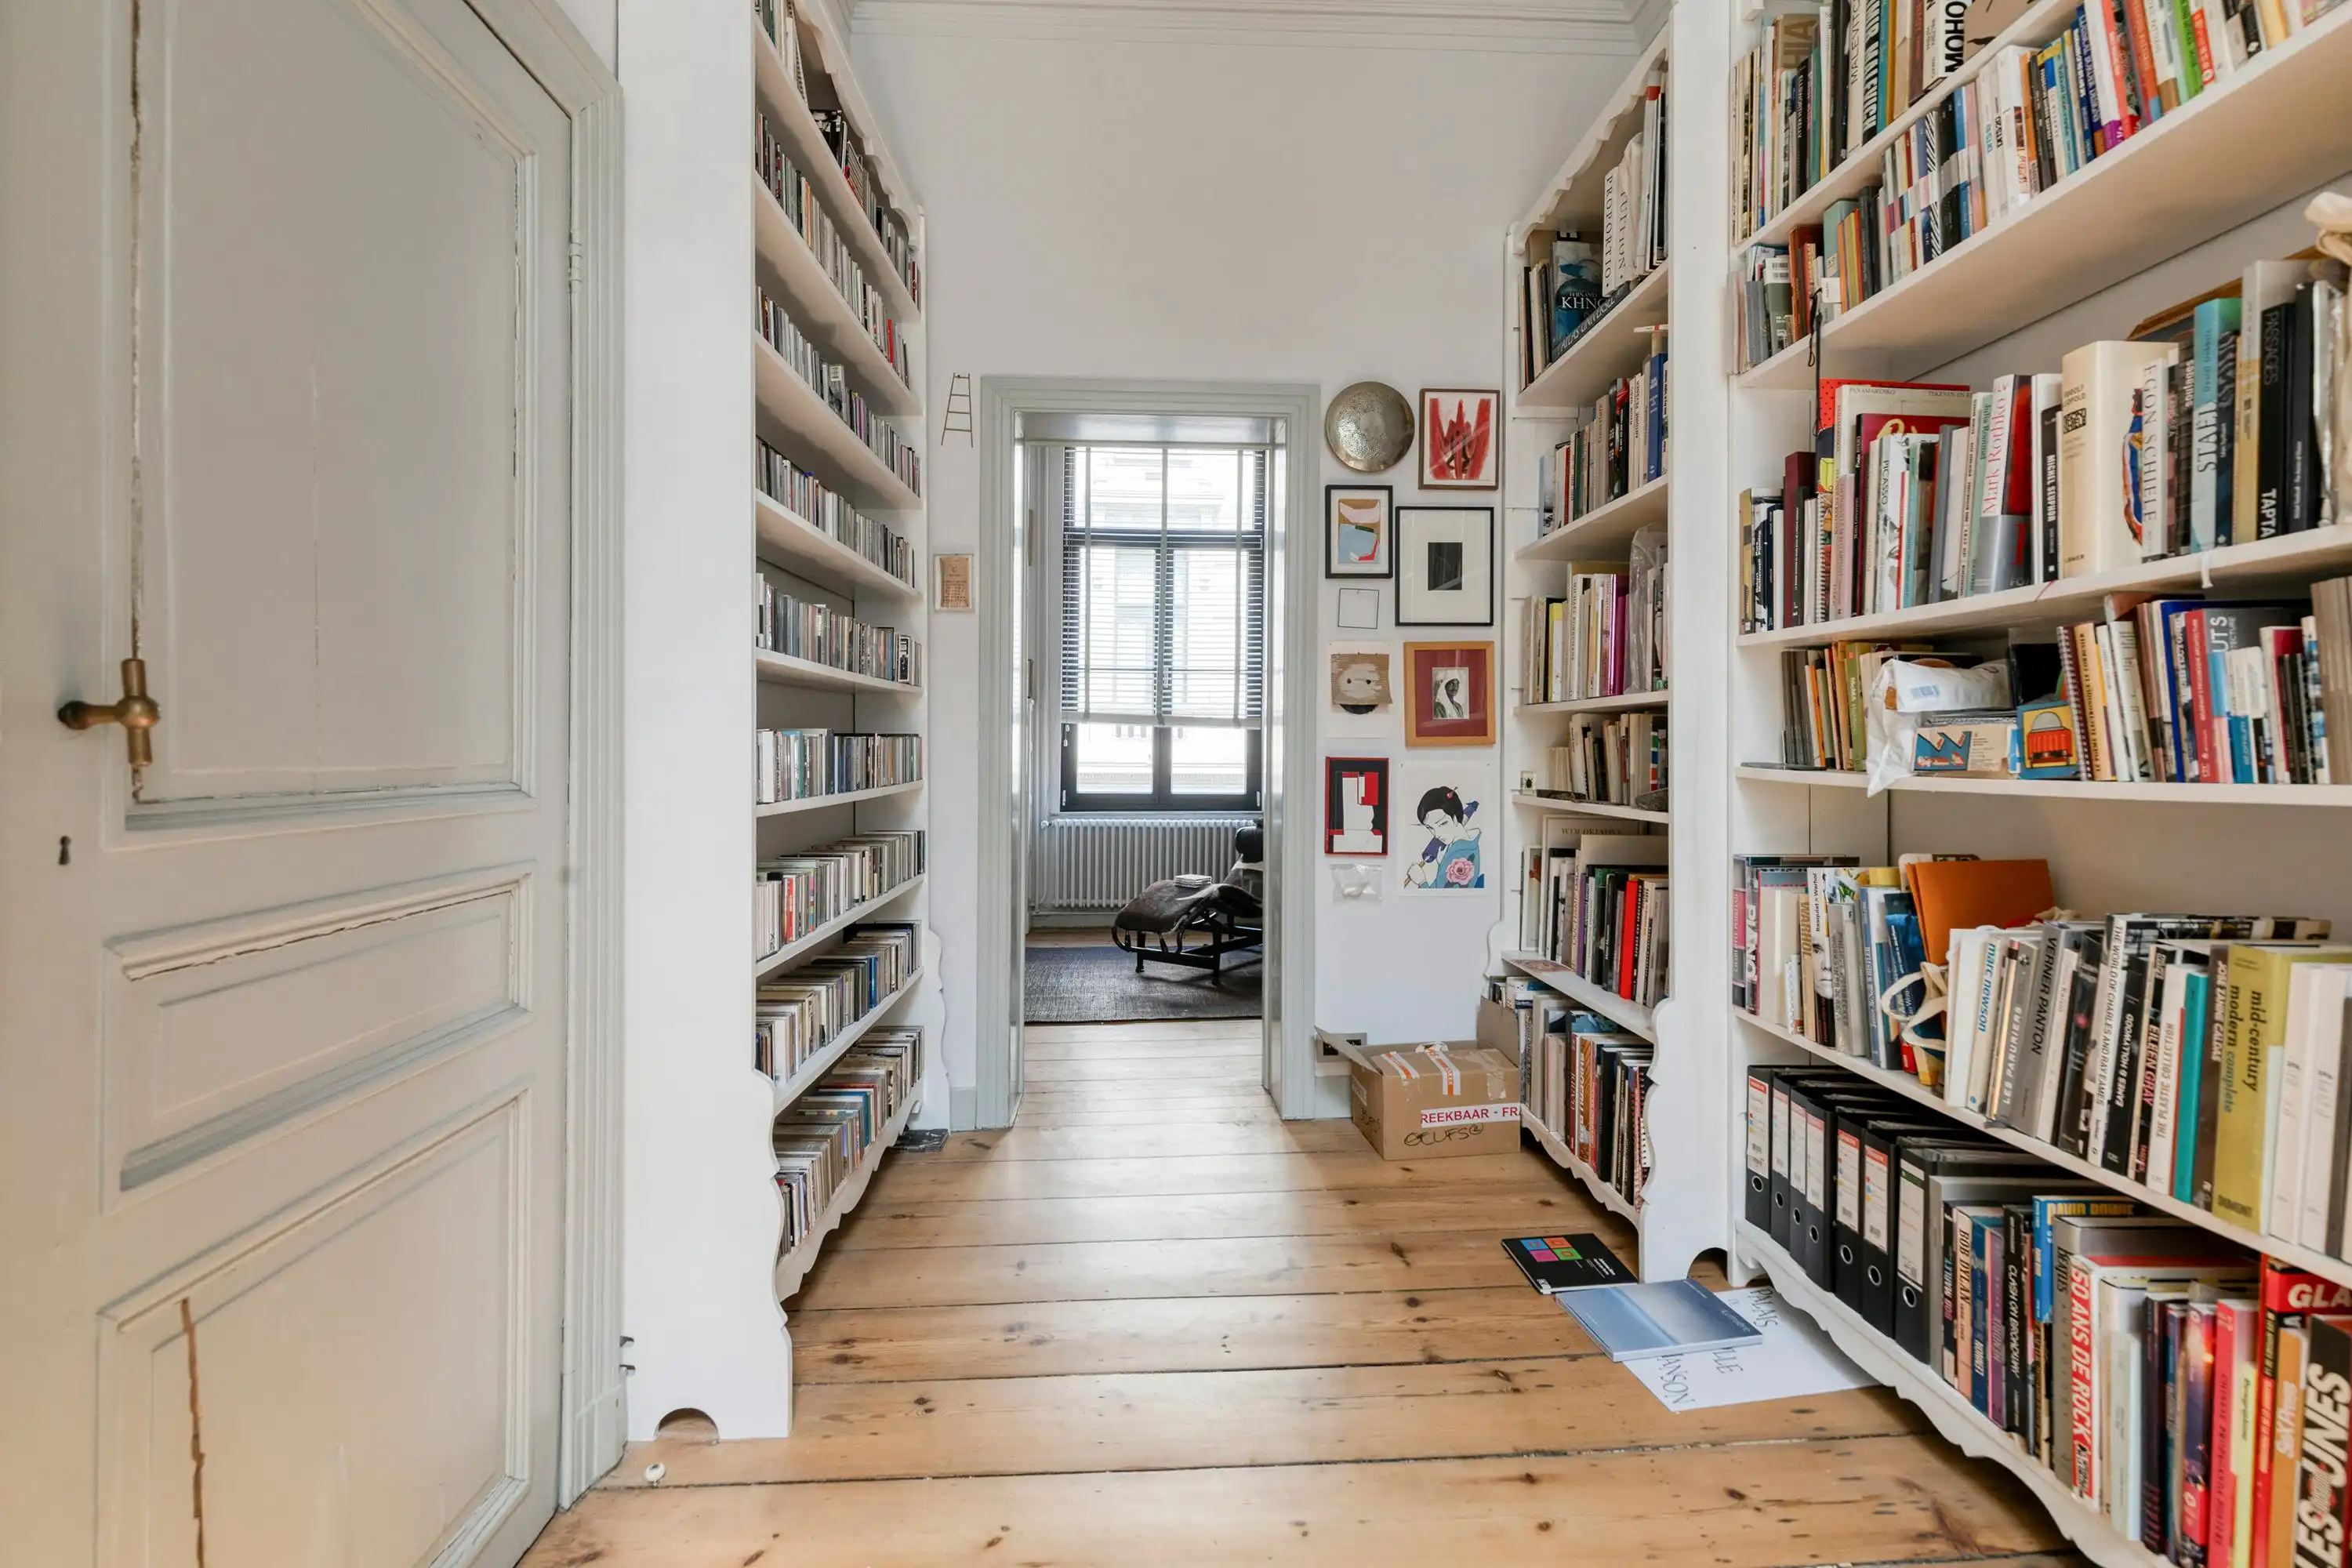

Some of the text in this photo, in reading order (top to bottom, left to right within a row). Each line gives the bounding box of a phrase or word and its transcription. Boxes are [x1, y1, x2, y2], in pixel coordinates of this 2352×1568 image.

[1605, 175, 1613, 278] PROPORTIO
[1982, 397, 2007, 514] Mark Rothko
[2143, 364, 2158, 523] EGON SCHIELE
[2196, 408, 2216, 473] STAEL
[1881, 459, 1889, 506] PICASSO
[2046, 454, 2056, 485] MICHEL
[2260, 488, 2277, 538] TAPTA
[1800, 901, 1812, 957] WARHOL
[2113, 925, 2123, 942] THE
[2108, 945, 2121, 978] WORLD
[1977, 942, 1998, 1033] marc newson
[2031, 936, 2059, 1055] VERNER PANTON
[2107, 979, 2117, 992] OF
[2103, 993, 2116, 1035] CHARLES
[2101, 1035, 2112, 1055] AND
[2119, 1013, 2135, 1069] HOLLYWOOD
[2222, 985, 2245, 1114] modern complete
[2245, 989, 2267, 1092] mid-century
[2100, 1055, 2111, 1074] RAY
[2143, 1024, 2160, 1106] EILEEN GRAY
[2157, 1022, 2176, 1139] THE PLASTIC COLLECTION
[1502, 1106, 1522, 1117] FR
[2002, 1081, 2014, 1105] LES
[2096, 1074, 2108, 1106] EAMES
[2115, 1077, 2126, 1107] EAMES
[1959, 1229, 1971, 1255] BOB
[1959, 1258, 1971, 1305] DYLAN
[2070, 1269, 2089, 1295] 50
[1745, 1287, 1778, 1328] PALAIS
[1944, 1298, 1953, 1321] BOB
[2008, 1264, 2020, 1378] CLASH ON BROADWAY
[2071, 1298, 2090, 1339] ANS
[2072, 1351, 2090, 1377] DE
[2072, 1379, 2092, 1444] ROCK
